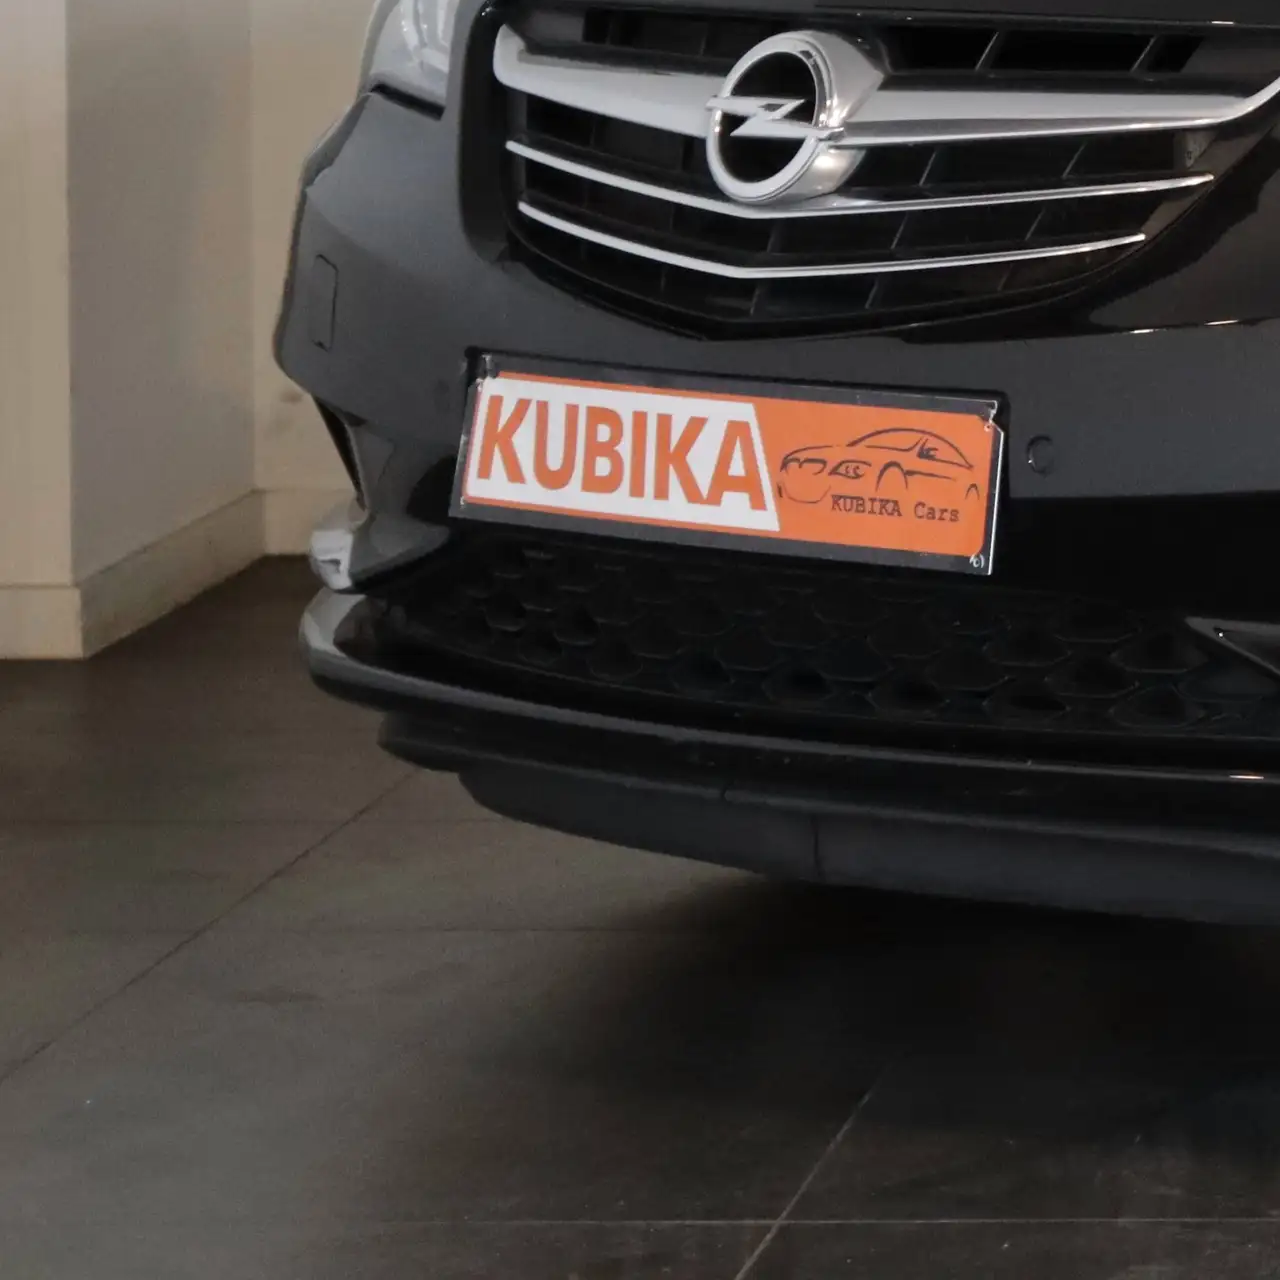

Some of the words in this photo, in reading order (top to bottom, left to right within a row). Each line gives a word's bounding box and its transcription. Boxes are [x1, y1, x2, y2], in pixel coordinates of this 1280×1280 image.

[477, 394, 768, 511] KUBIKA
[831, 494, 903, 517] KUBIKA
[913, 501, 960, 522] Cars
